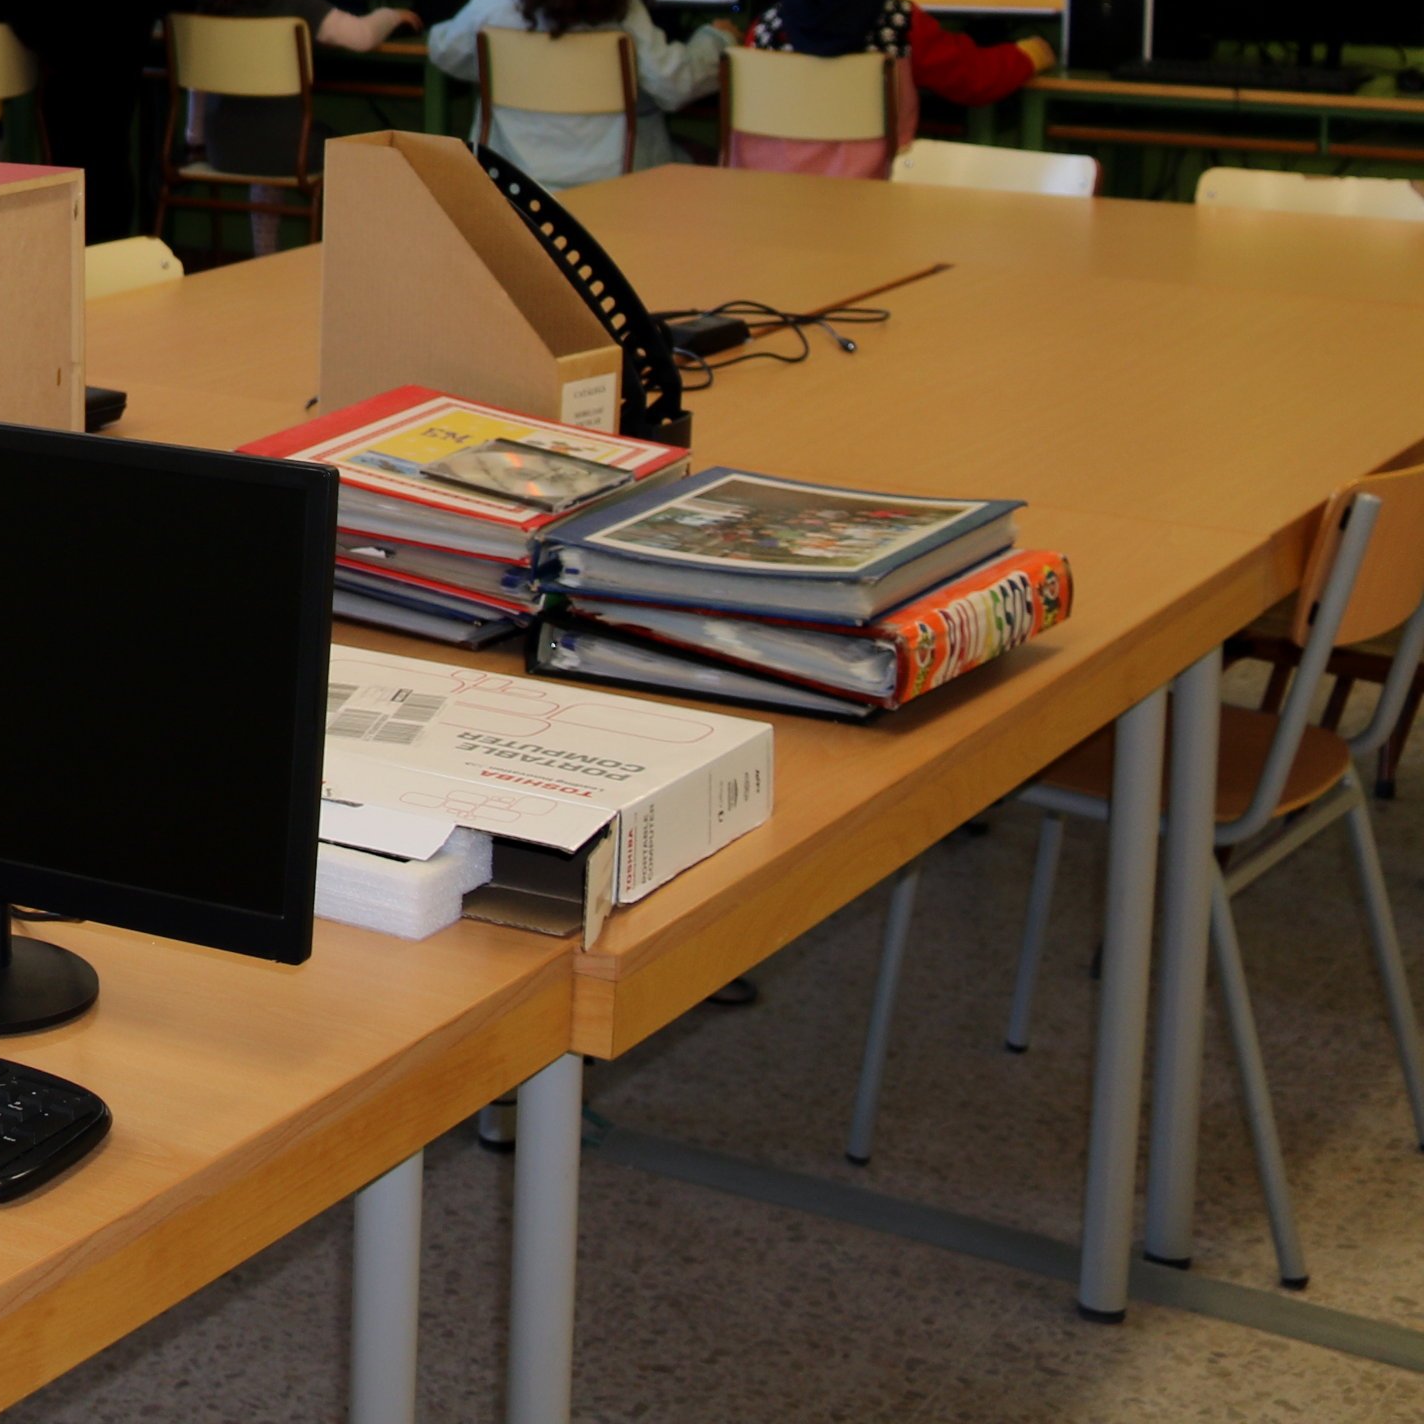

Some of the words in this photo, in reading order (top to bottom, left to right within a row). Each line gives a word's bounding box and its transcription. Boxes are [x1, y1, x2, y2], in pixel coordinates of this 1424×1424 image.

[454, 742, 632, 782] PORTABLE
[456, 731, 647, 773] COMPUTER
[480, 769, 593, 798] TOSHIBA
[625, 828, 634, 892] TOSHIBA
